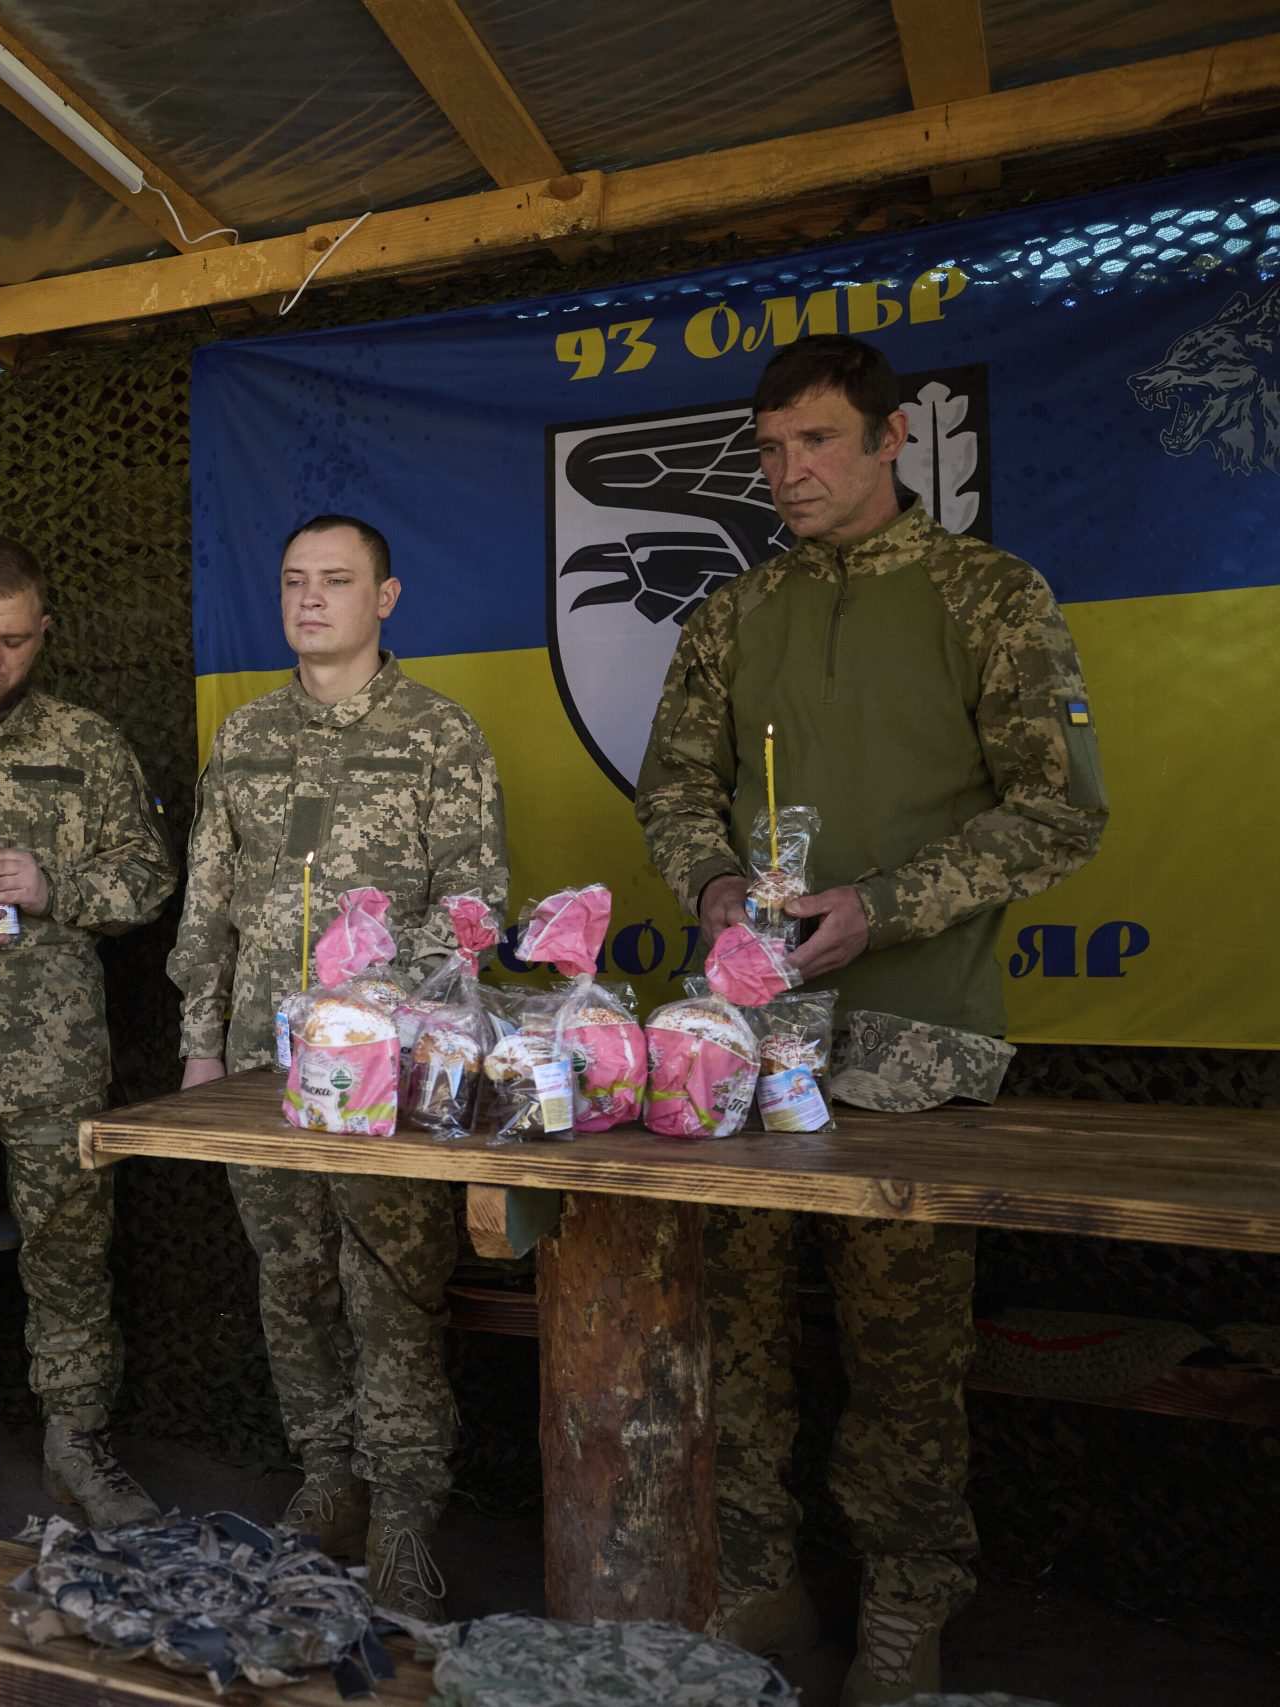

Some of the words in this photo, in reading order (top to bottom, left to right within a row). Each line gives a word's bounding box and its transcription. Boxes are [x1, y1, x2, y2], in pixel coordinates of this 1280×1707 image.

[555, 317, 657, 382] 93
[684, 266, 967, 359] ОМБР
[1008, 920, 1151, 979] ЯР
